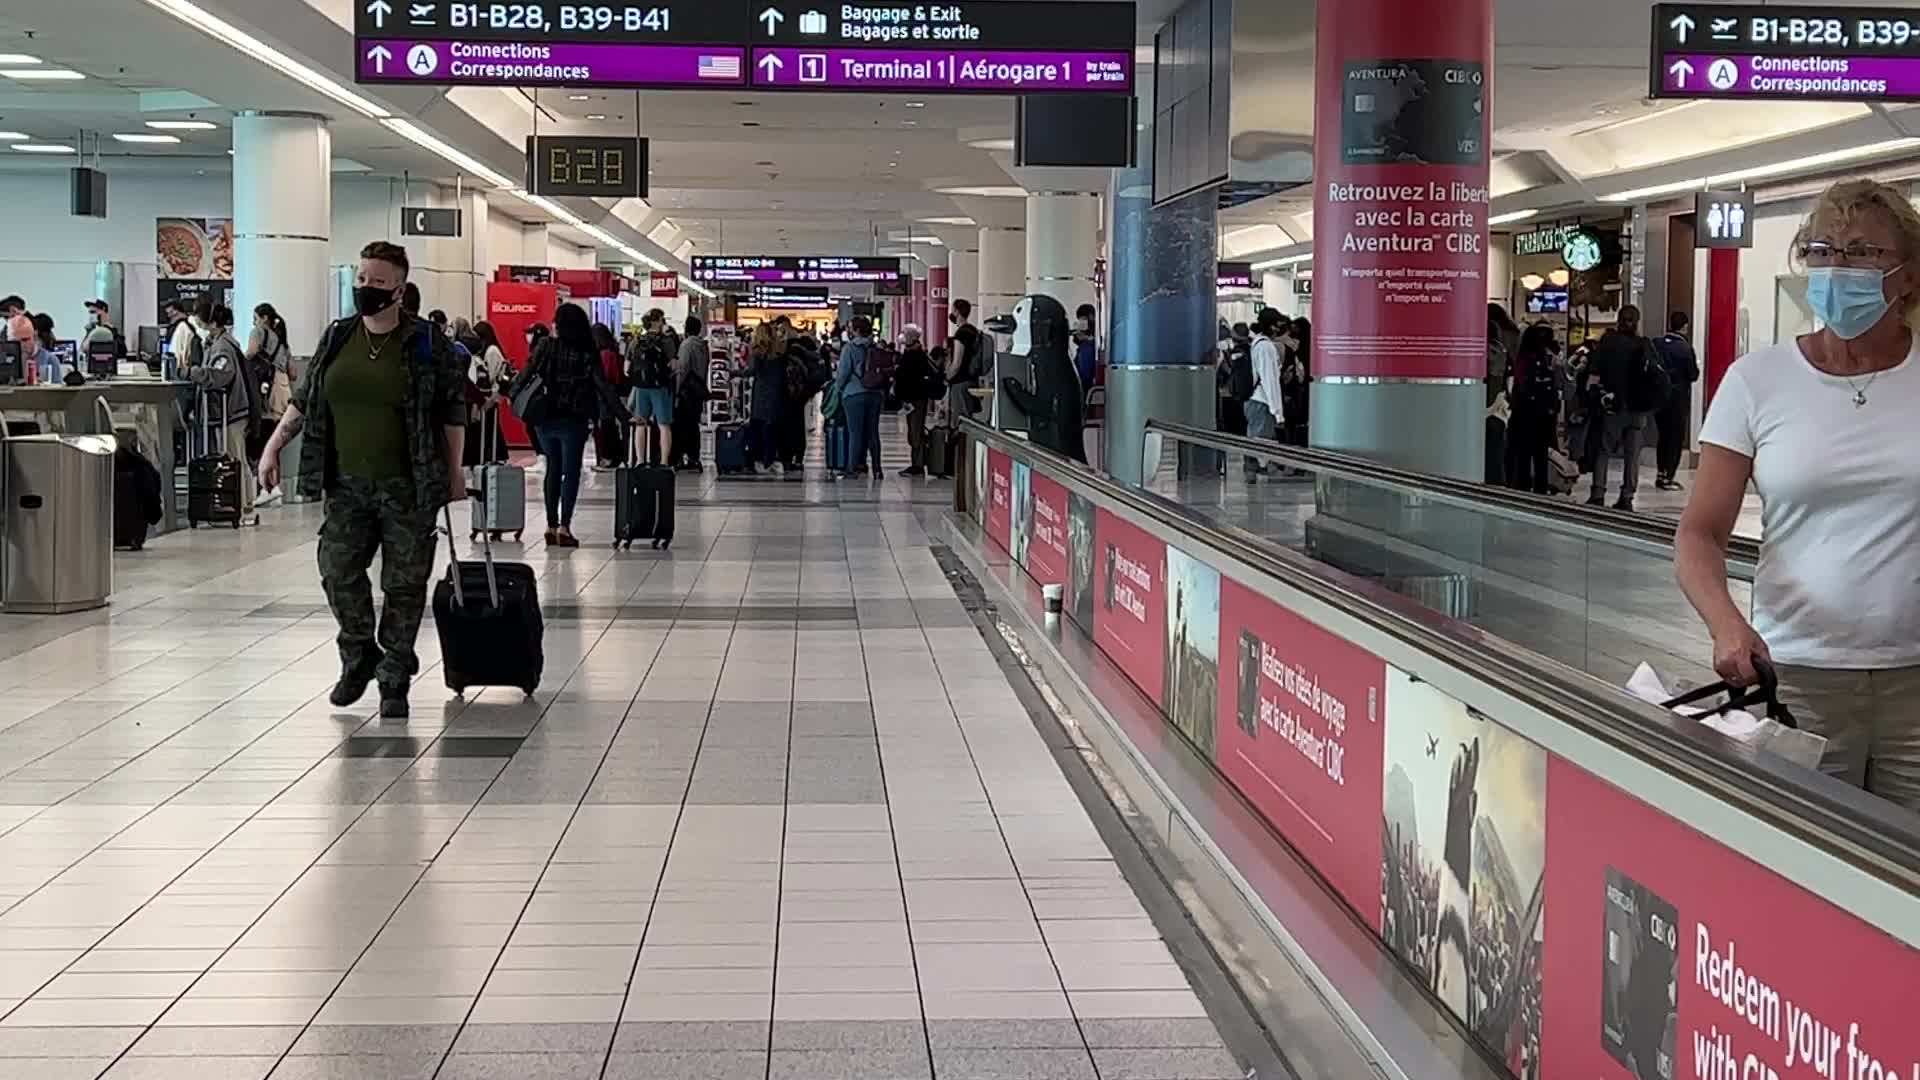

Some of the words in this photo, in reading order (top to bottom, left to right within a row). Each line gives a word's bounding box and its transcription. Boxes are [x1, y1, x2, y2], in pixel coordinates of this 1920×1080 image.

[451, 4, 551, 32] B1-B28,
[560, 7, 670, 31] B39-B41
[841, 5, 909, 23] Baggage
[915, 7, 926, 21] &
[930, 6, 961, 22] Exit
[841, 22, 908, 41] Bagages
[912, 25, 930, 39] et
[934, 25, 980, 40] sortie
[1751, 18, 1849, 47] B1-B28,
[450, 42, 550, 60] Connections
[450, 61, 590, 79] Correspondances
[840, 58, 932, 79] Terminal
[959, 59, 1057, 84] Aérogare
[1061, 62, 1070, 81] 1
[1751, 56, 1848, 73] Connections
[1349, 69, 1406, 80] AVENTURA
[1750, 75, 1887, 93] Correspondances
[1329, 183, 1424, 205] Retrouvez
[1430, 182, 1446, 201] la
[415, 211, 426, 232] C
[1356, 211, 1400, 226] avec
[1407, 207, 1425, 225] la
[1430, 210, 1473, 227] carte
[1446, 234, 1480, 253] CIBC
[652, 278, 677, 291] RELAY
[1695, 922, 1780, 1042] Redeem
[1785, 1000, 1842, 1080] your
